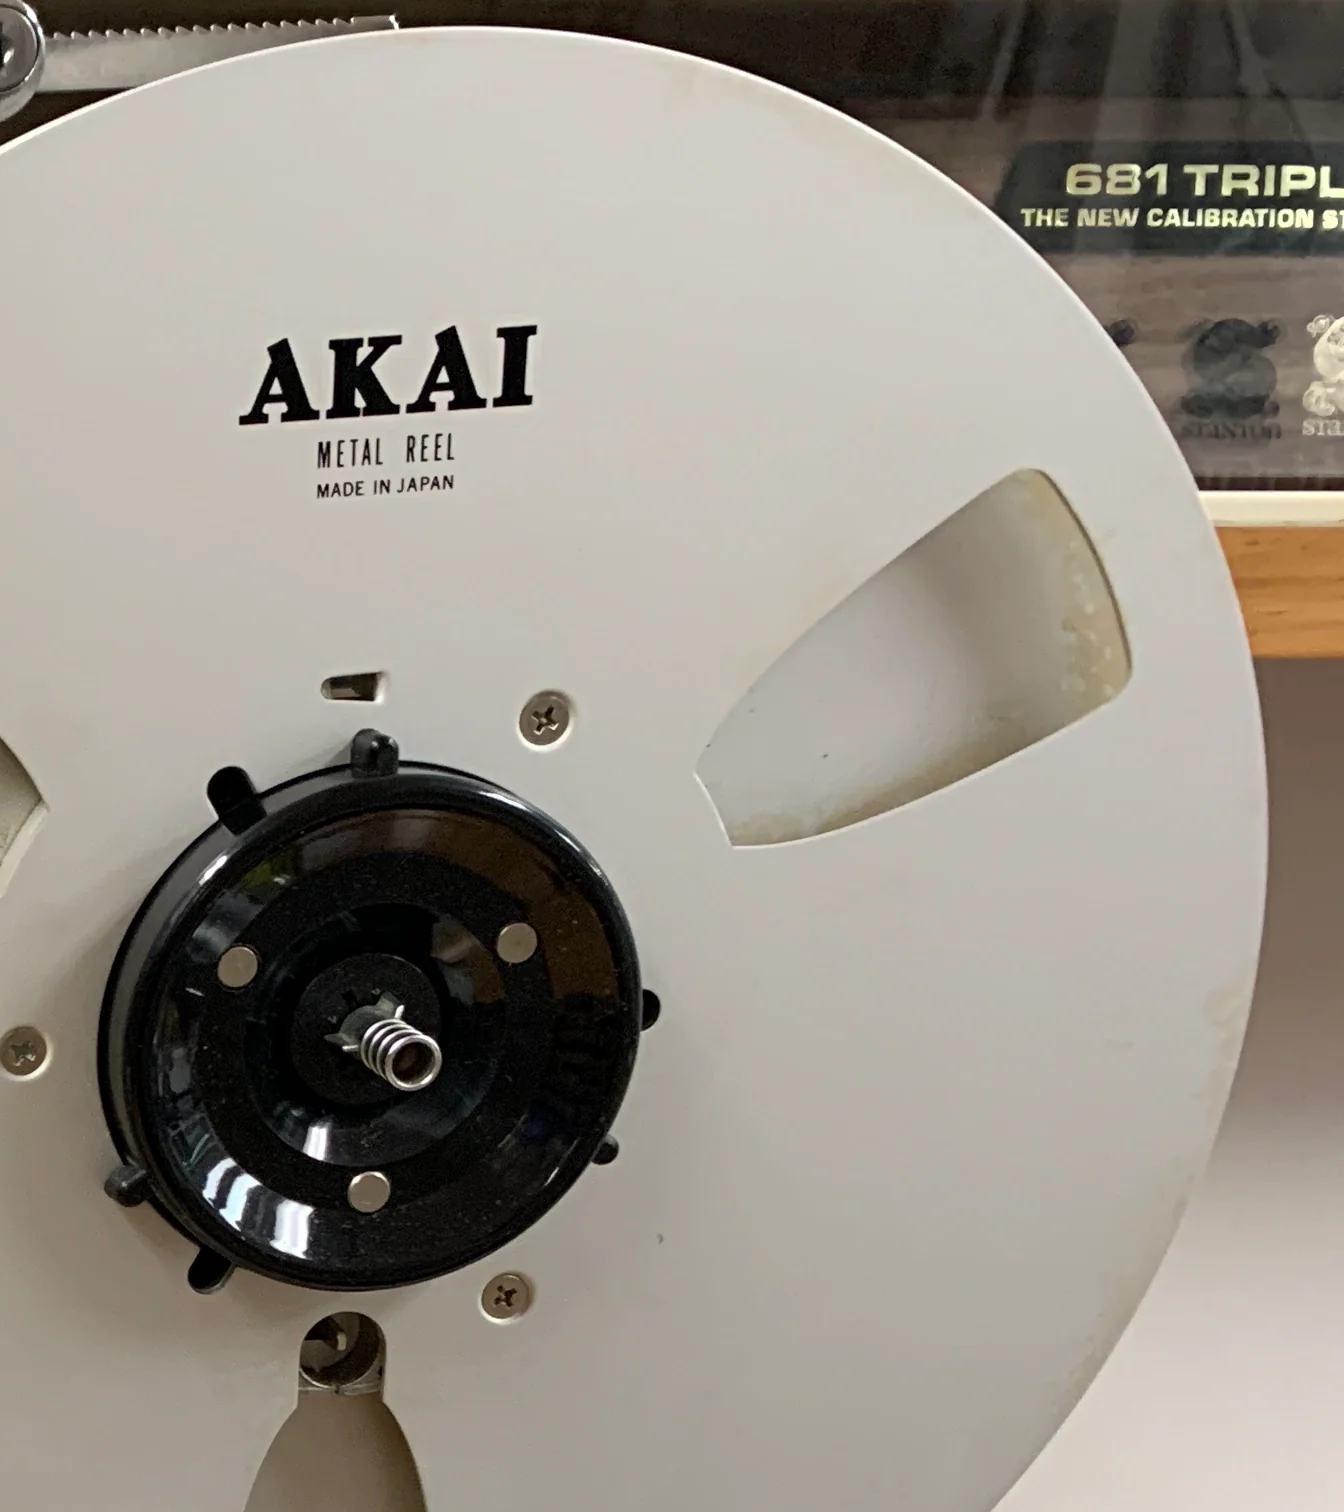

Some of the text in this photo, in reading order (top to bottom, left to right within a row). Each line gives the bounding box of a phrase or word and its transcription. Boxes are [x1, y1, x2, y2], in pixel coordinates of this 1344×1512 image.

[1066, 163, 1344, 198] 681 TRIPL
[1020, 208, 1069, 227] THE
[1077, 208, 1139, 227] NEW
[1146, 208, 1314, 229] CALIBRATION
[239, 325, 538, 425] AKAI
[317, 433, 455, 469] METAL REEL
[317, 475, 454, 499] MADE IN JAPAN
